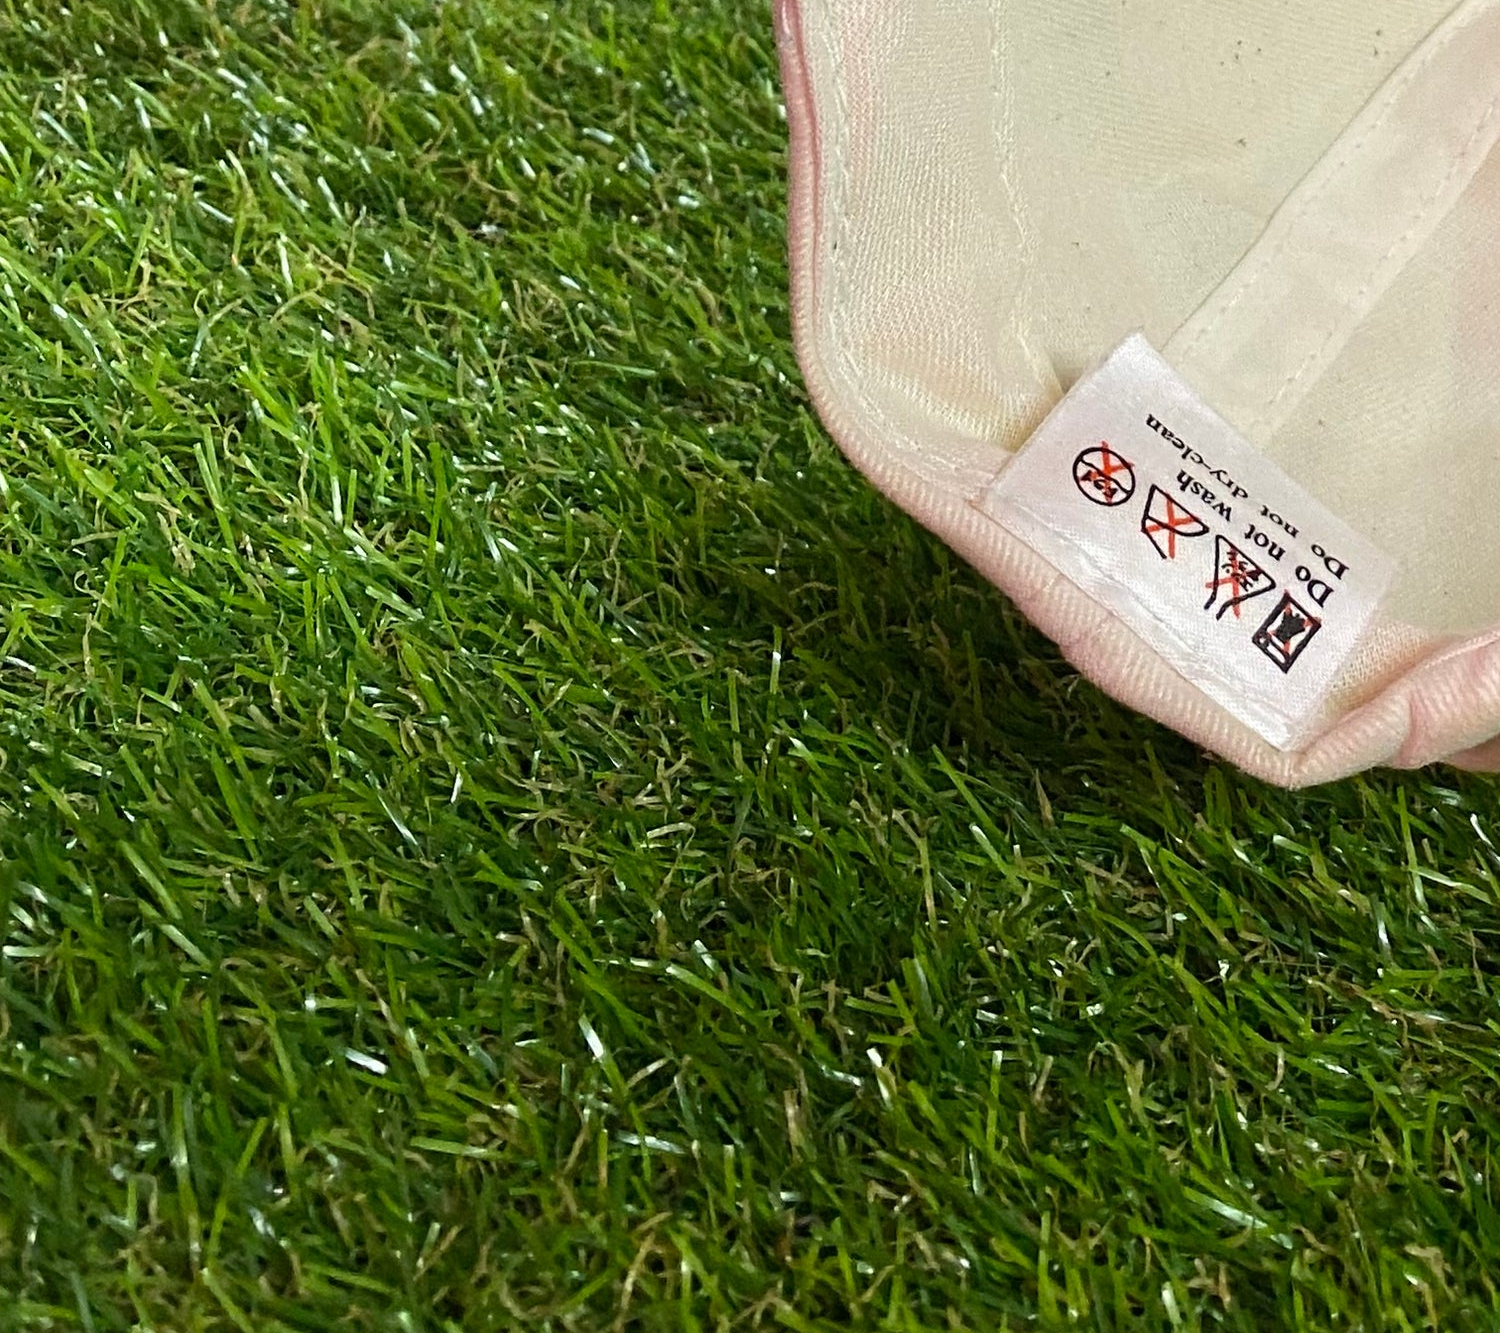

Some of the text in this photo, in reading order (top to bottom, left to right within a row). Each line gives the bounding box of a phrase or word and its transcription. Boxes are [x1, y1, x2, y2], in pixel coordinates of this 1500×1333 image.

[1145, 413, 1350, 581] Do not dry-clean
[1175, 468, 1335, 609] Do not wash
